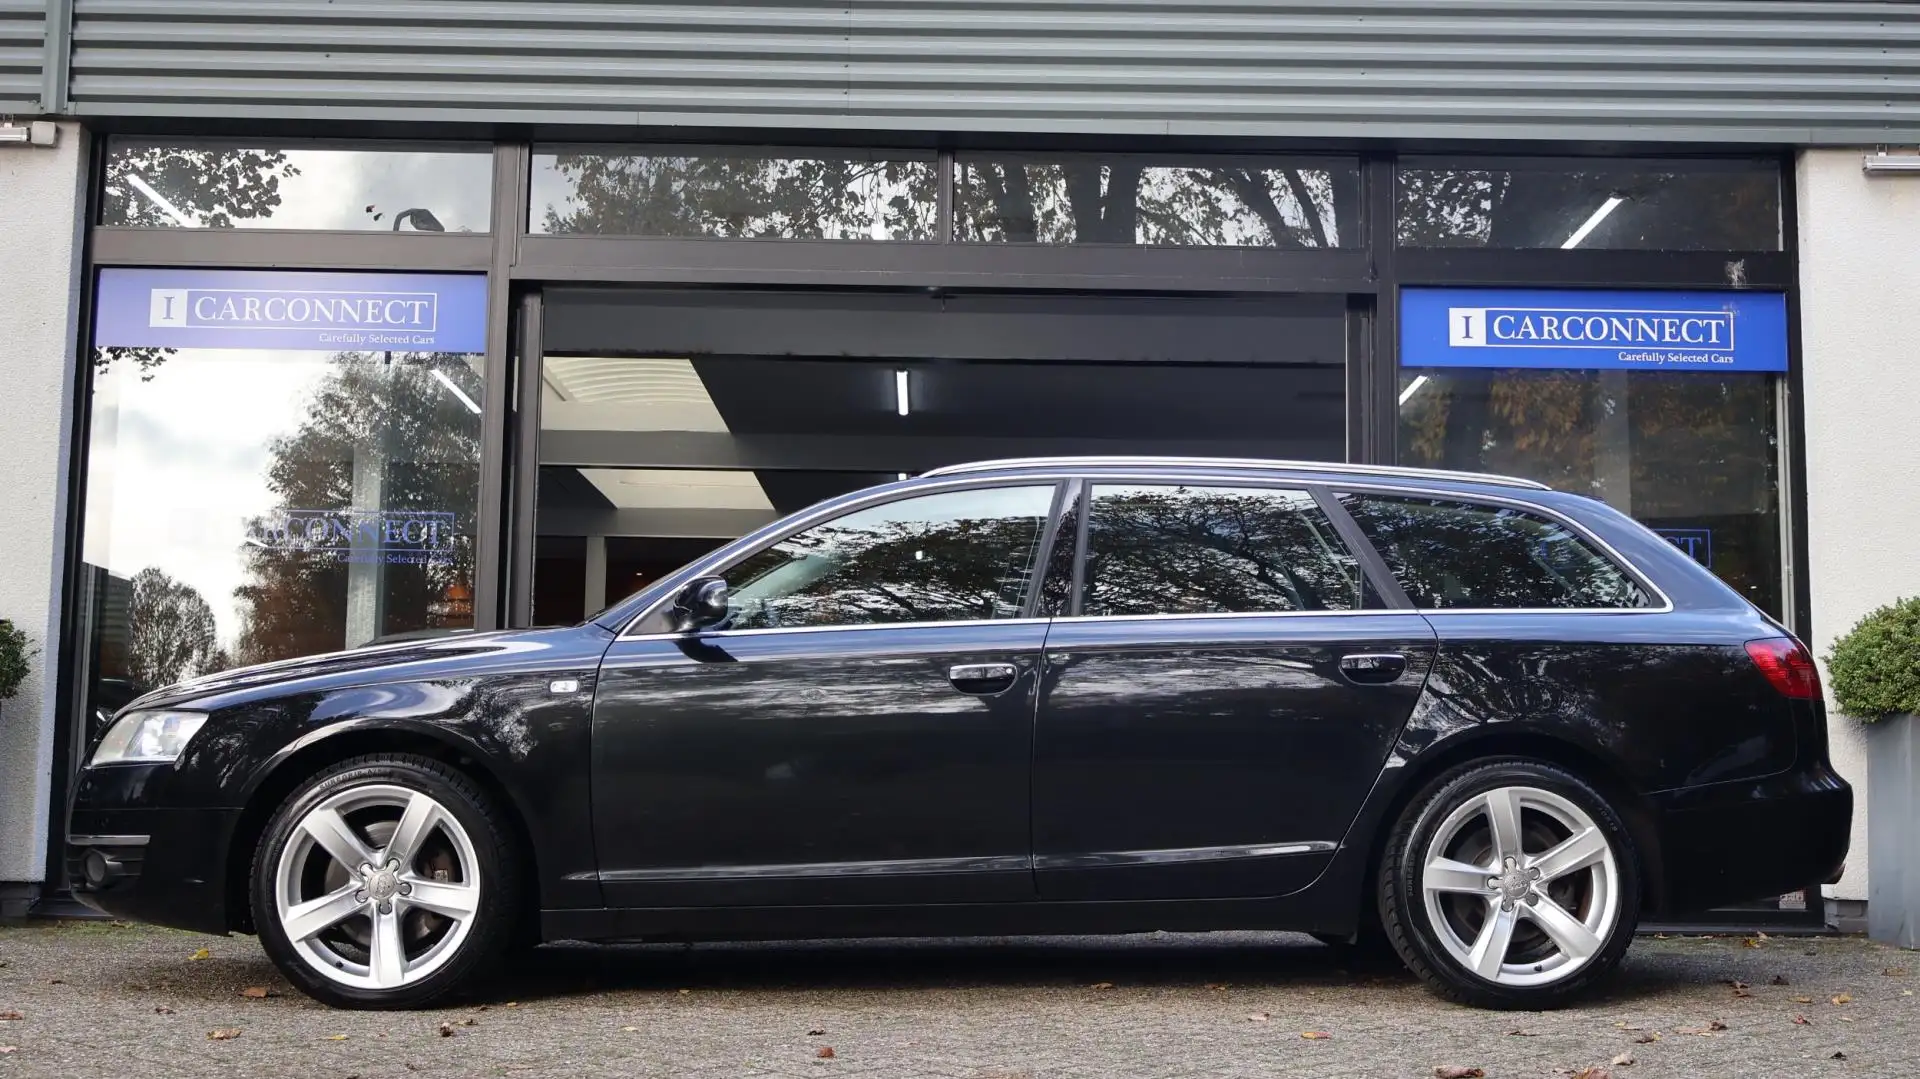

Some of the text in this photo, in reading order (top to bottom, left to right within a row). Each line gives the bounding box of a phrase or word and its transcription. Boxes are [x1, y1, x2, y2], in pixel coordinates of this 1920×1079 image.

[162, 296, 429, 324] I CARCONNECT
[319, 333, 435, 345] Carefully Selected Cars
[1461, 315, 1725, 343] I CARCONNECT
[1618, 351, 1734, 364] Carefully Selected Cars
